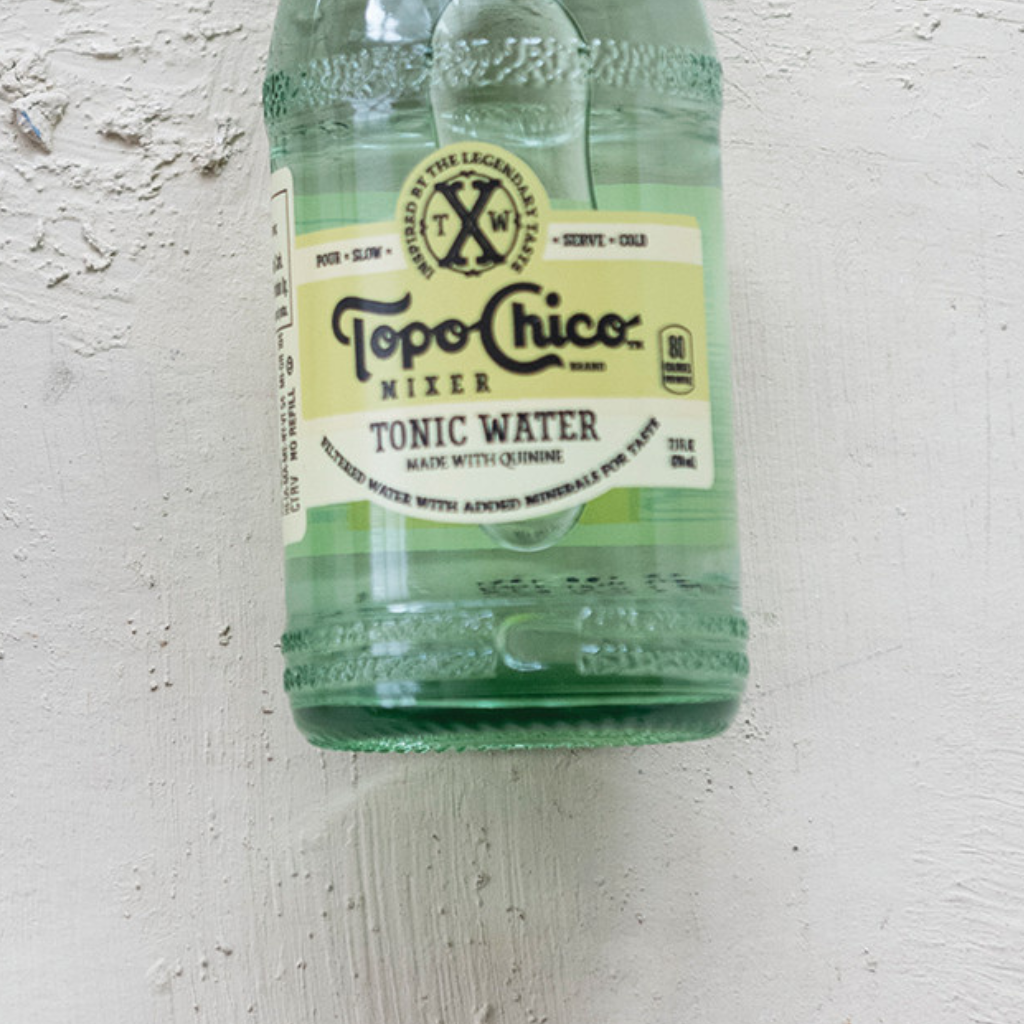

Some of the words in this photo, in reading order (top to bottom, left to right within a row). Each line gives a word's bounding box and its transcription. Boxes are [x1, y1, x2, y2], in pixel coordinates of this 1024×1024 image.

[411, 176, 428, 198] BY
[426, 154, 460, 178] THE
[462, 151, 538, 217] LEGENDARY
[405, 201, 435, 279] INSPIRED
[433, 214, 449, 236] T
[435, 179, 505, 266] X
[488, 210, 512, 232] W
[510, 223, 538, 274] TASTE
[332, 291, 479, 382] Topo
[479, 282, 641, 375] Chico
[381, 372, 491, 400] MIXER
[370, 414, 467, 453] TONIC
[478, 409, 600, 444] WATER
[321, 435, 367, 484] FILTERED
[368, 478, 412, 506] WATER
[415, 495, 458, 512] WITH
[463, 498, 522, 514] ADDED
[524, 469, 602, 506] MINERALS
[600, 452, 629, 477] FOR
[626, 416, 661, 456] TASTE
[406, 454, 449, 472] MADE
[452, 453, 496, 469] WITH
[499, 450, 564, 470] QUININE
